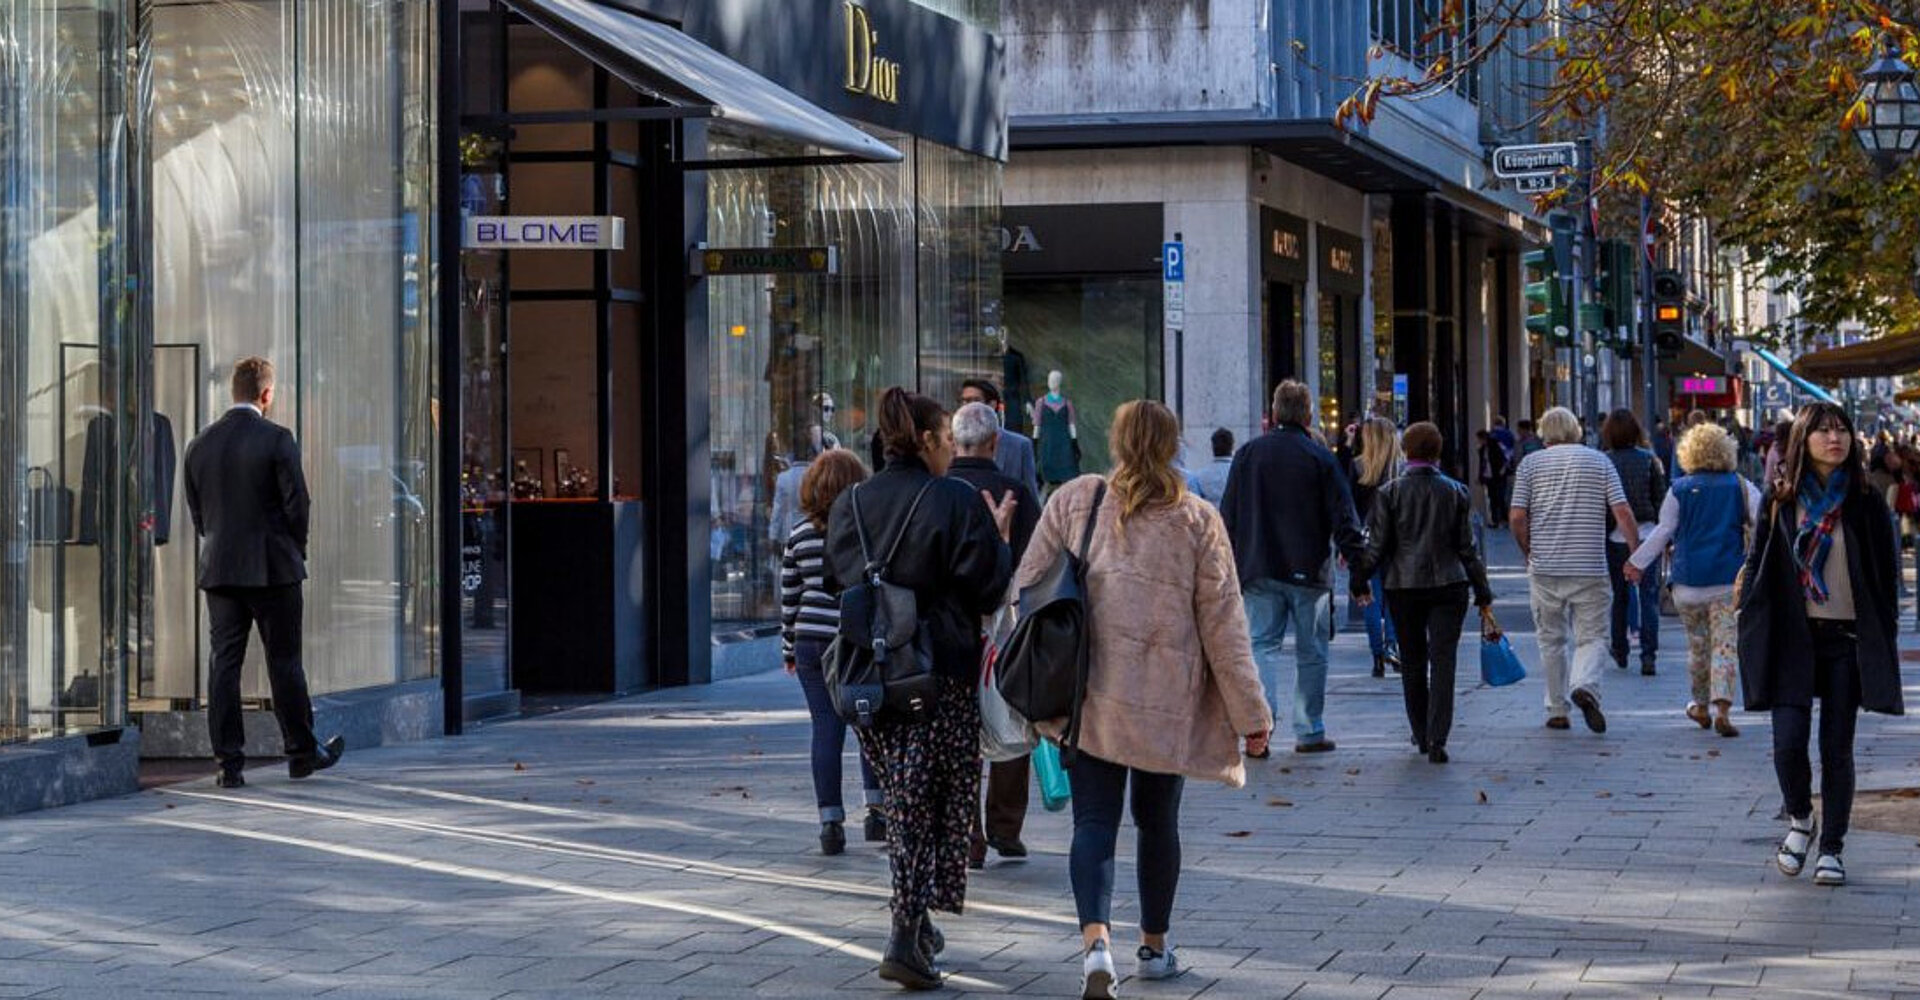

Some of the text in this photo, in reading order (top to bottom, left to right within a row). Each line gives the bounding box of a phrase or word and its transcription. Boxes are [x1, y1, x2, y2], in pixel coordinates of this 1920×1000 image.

[843, 1, 900, 104] Dior
[477, 223, 598, 243] BLOME
[732, 252, 798, 268] ROLEX
[1168, 246, 1180, 277] P
